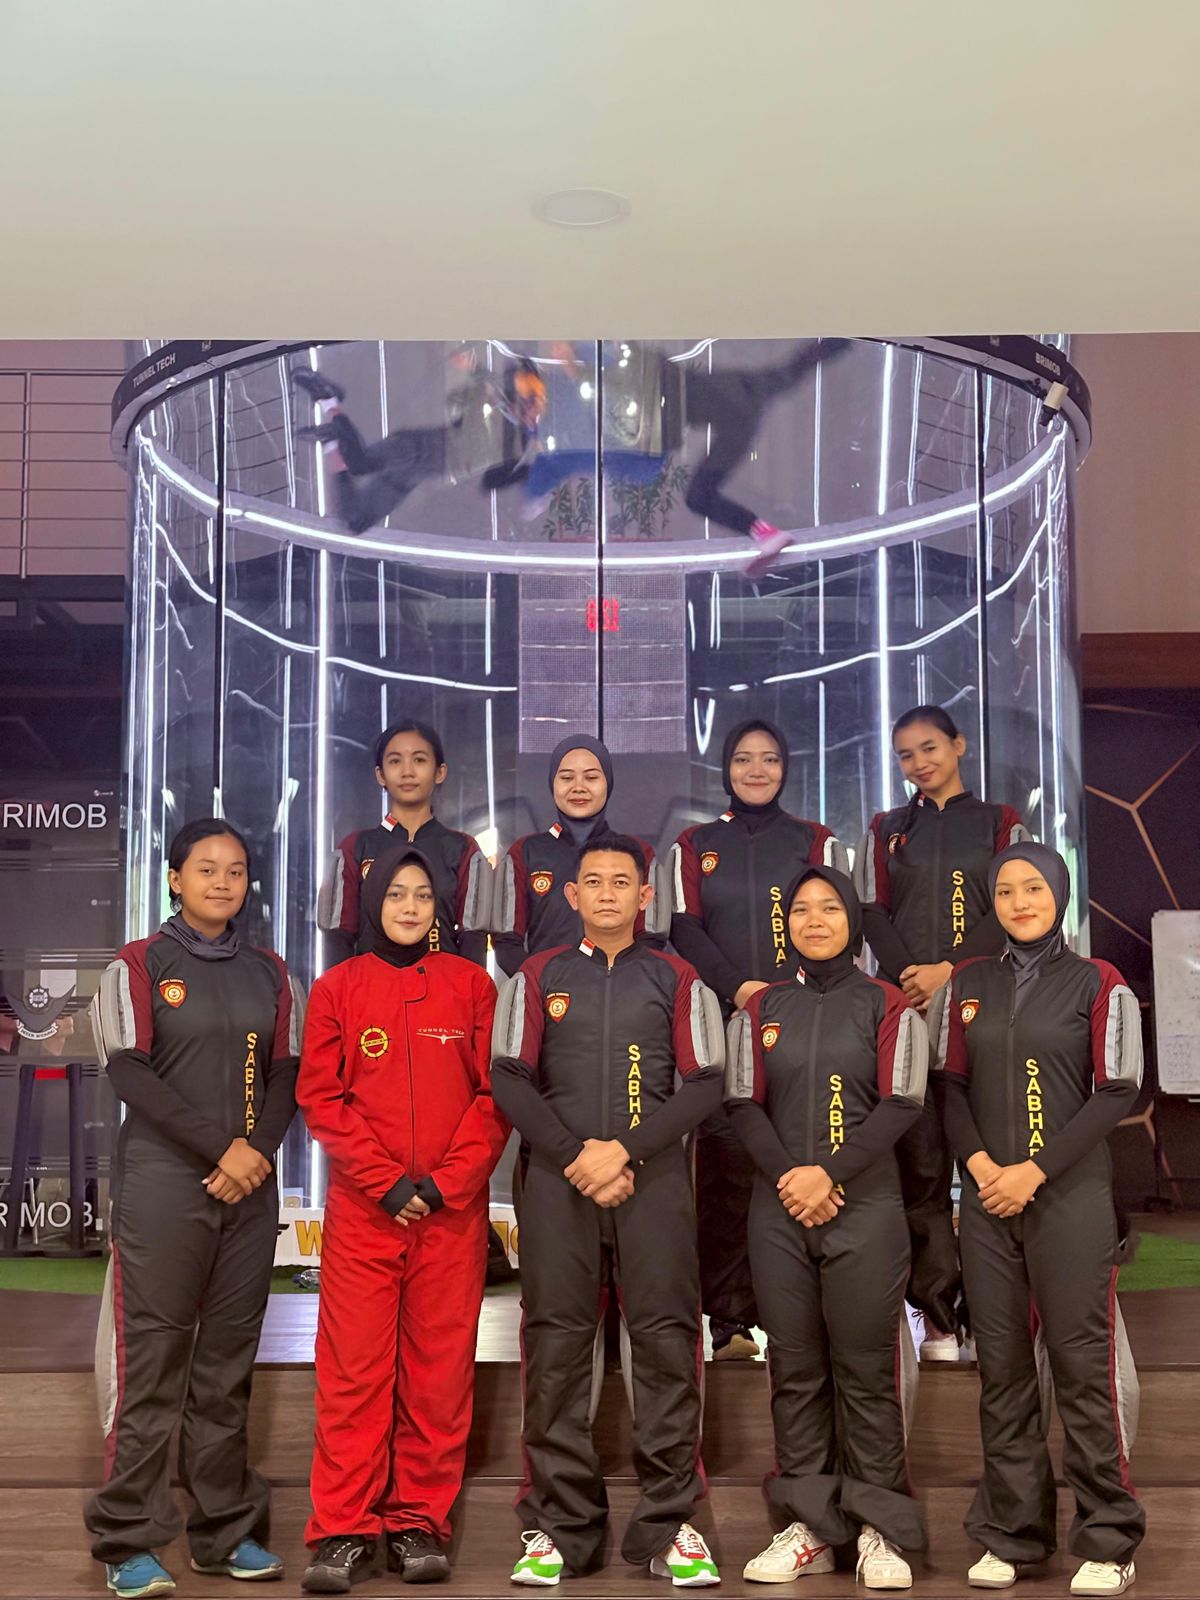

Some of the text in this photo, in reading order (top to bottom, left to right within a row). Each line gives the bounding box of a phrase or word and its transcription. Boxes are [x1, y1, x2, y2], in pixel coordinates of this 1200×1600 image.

[156, 353, 176, 371] TECH
[3, 803, 107, 829] RIMOB
[769, 886, 786, 968] SABHA
[952, 870, 965, 951] SABHA
